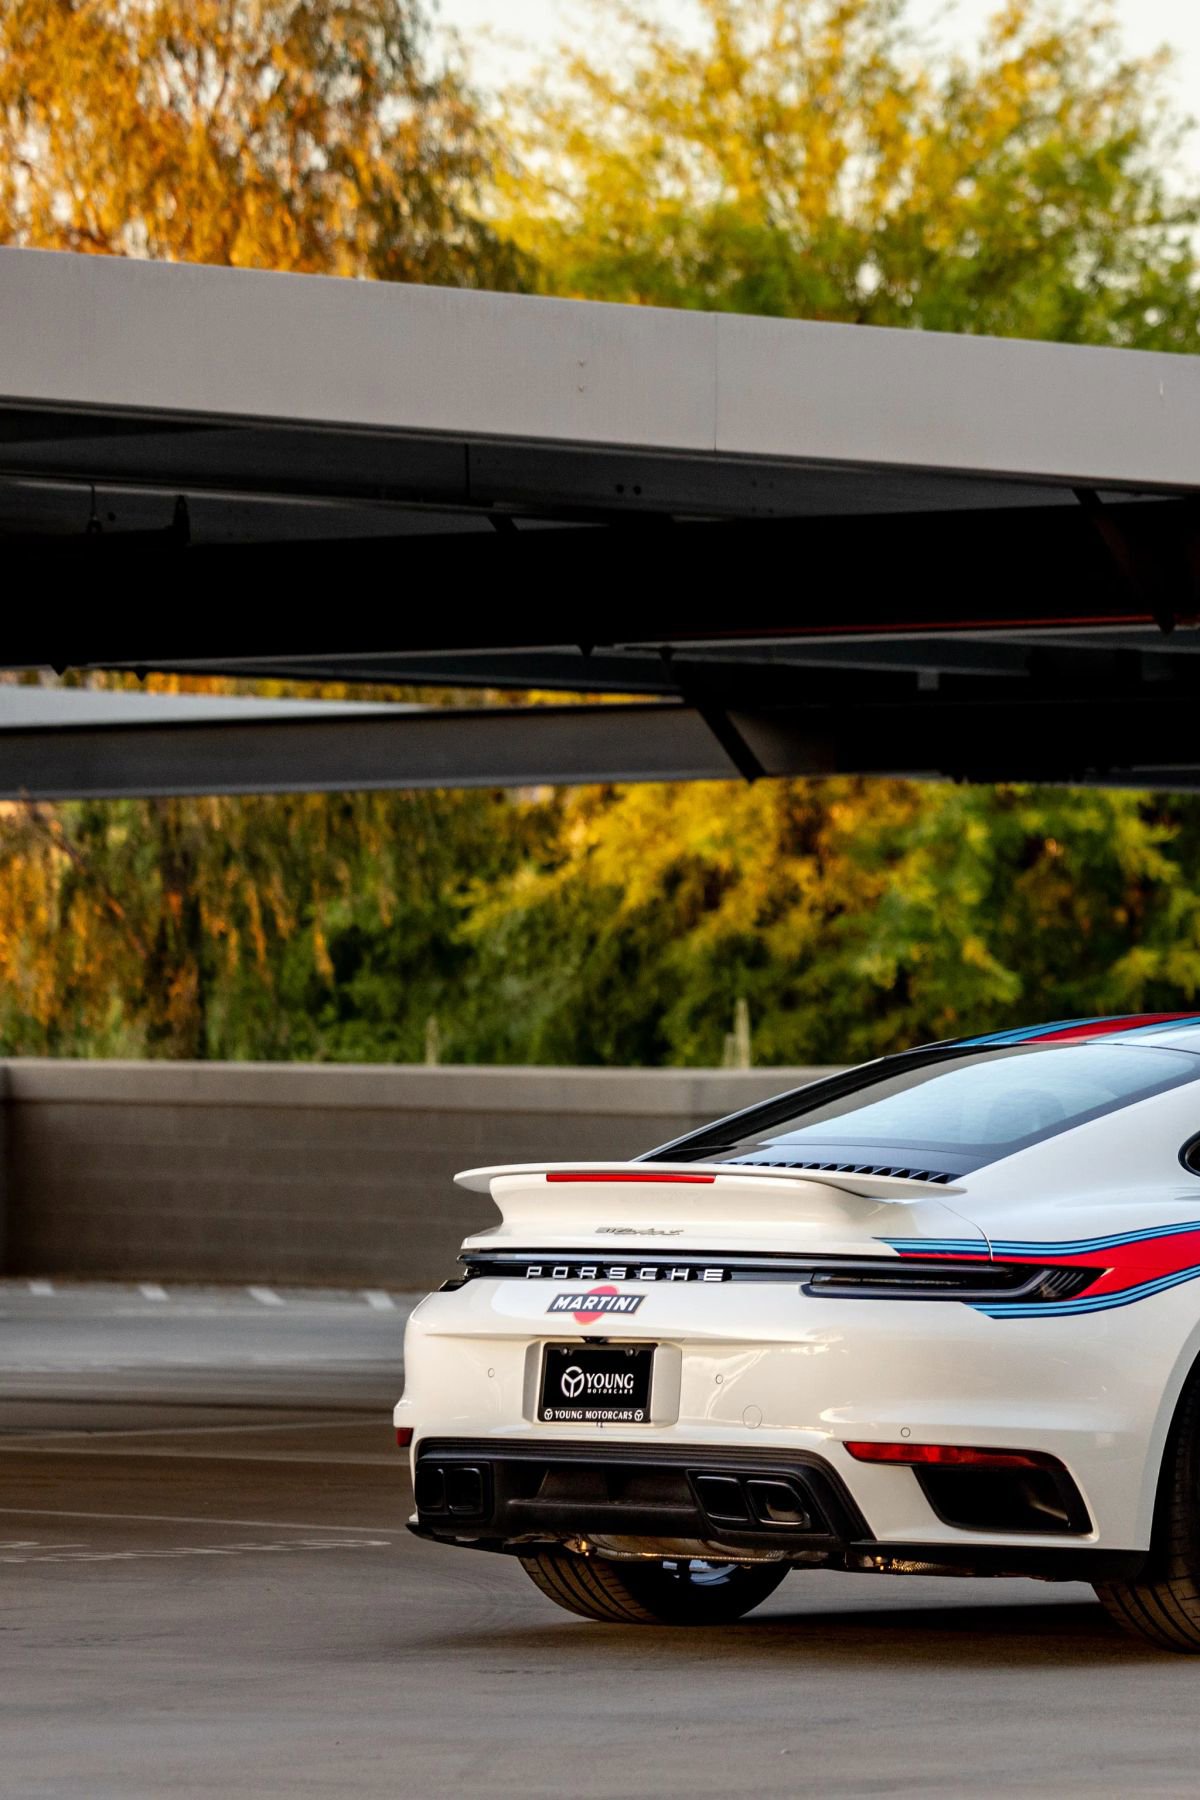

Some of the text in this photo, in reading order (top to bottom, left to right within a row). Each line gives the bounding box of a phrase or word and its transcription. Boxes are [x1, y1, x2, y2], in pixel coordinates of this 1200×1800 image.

[526, 1266, 724, 1282] PORSCHE
[553, 1296, 640, 1312] MARTINI
[586, 1373, 634, 1389] YOUNG
[554, 1410, 633, 1420] YOUNG MOTORCARS
